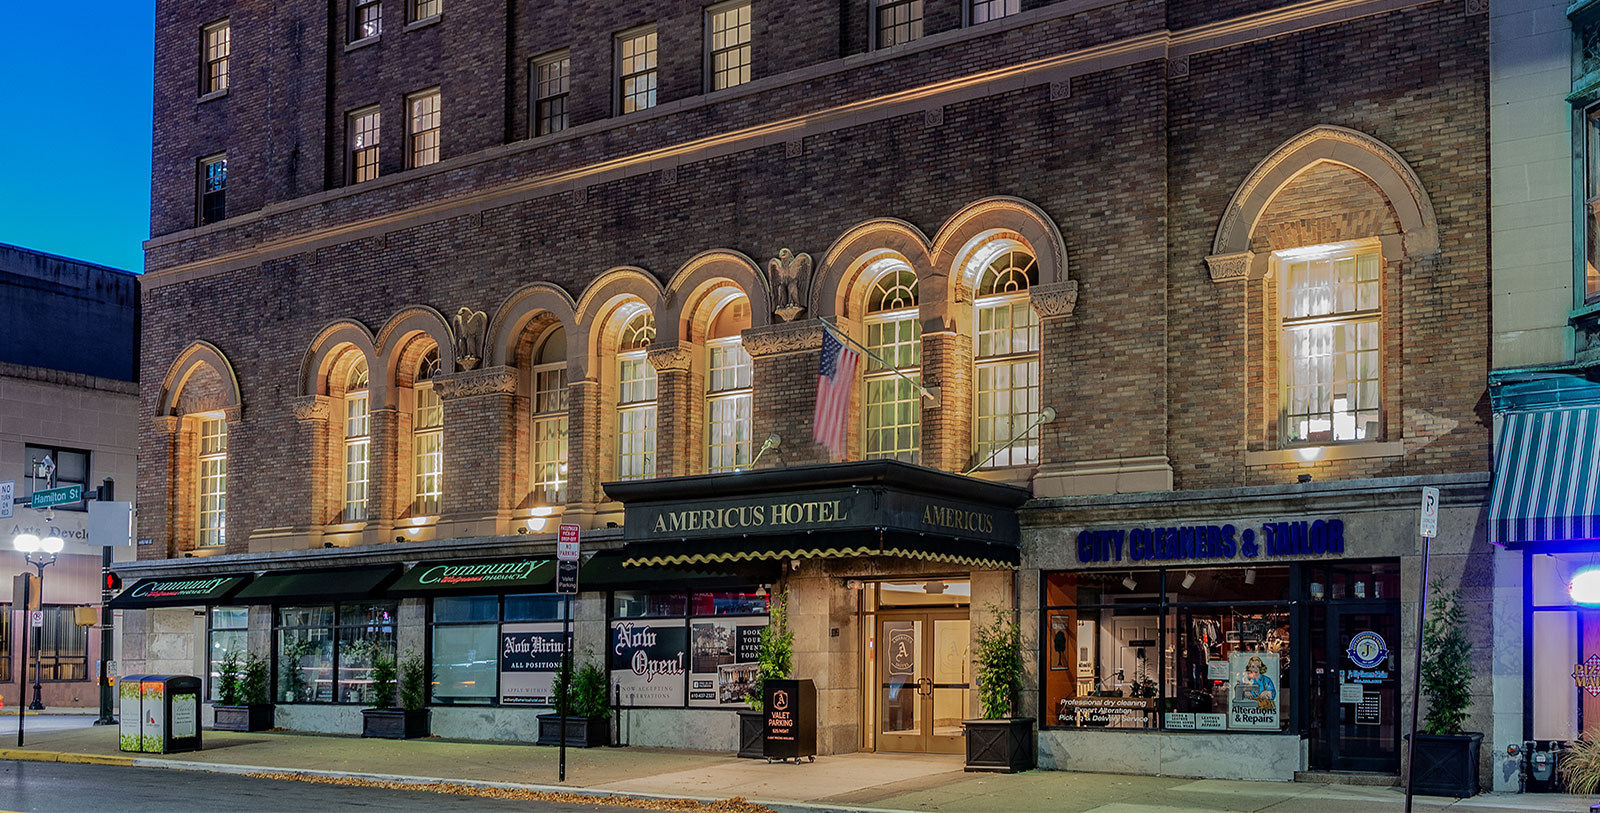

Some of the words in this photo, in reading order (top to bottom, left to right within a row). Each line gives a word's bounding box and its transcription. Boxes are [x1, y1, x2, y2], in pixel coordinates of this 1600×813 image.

[2, 484, 11, 493] NO
[34, 491, 66, 503] Hamilton
[69, 488, 79, 499] St
[653, 504, 765, 533] AMERICUS
[770, 500, 848, 525] HOTEL
[922, 504, 993, 534] AMERICUS
[1077, 529, 1126, 563] CITY
[1129, 523, 1238, 561] CLEANERS
[1241, 528, 1259, 559] &
[1263, 518, 1345, 557] TAILOR
[419, 559, 550, 584] Community
[131, 577, 232, 598] Community
[615, 622, 657, 655] Now
[504, 636, 530, 658] Now
[530, 636, 572, 658] Hiring!
[896, 641, 909, 662] A
[525, 661, 563, 669] POSITIONS
[631, 649, 684, 683] Open!
[1575, 664, 1600, 676] PIZ
[1116, 700, 1147, 708] cleaning
[1231, 705, 1277, 715] Alterations
[771, 711, 790, 719] VALET
[1092, 715, 1120, 723] Delivery
[1235, 714, 1242, 722] &
[1243, 714, 1274, 725] Repairs
[768, 719, 793, 727] PARKING
